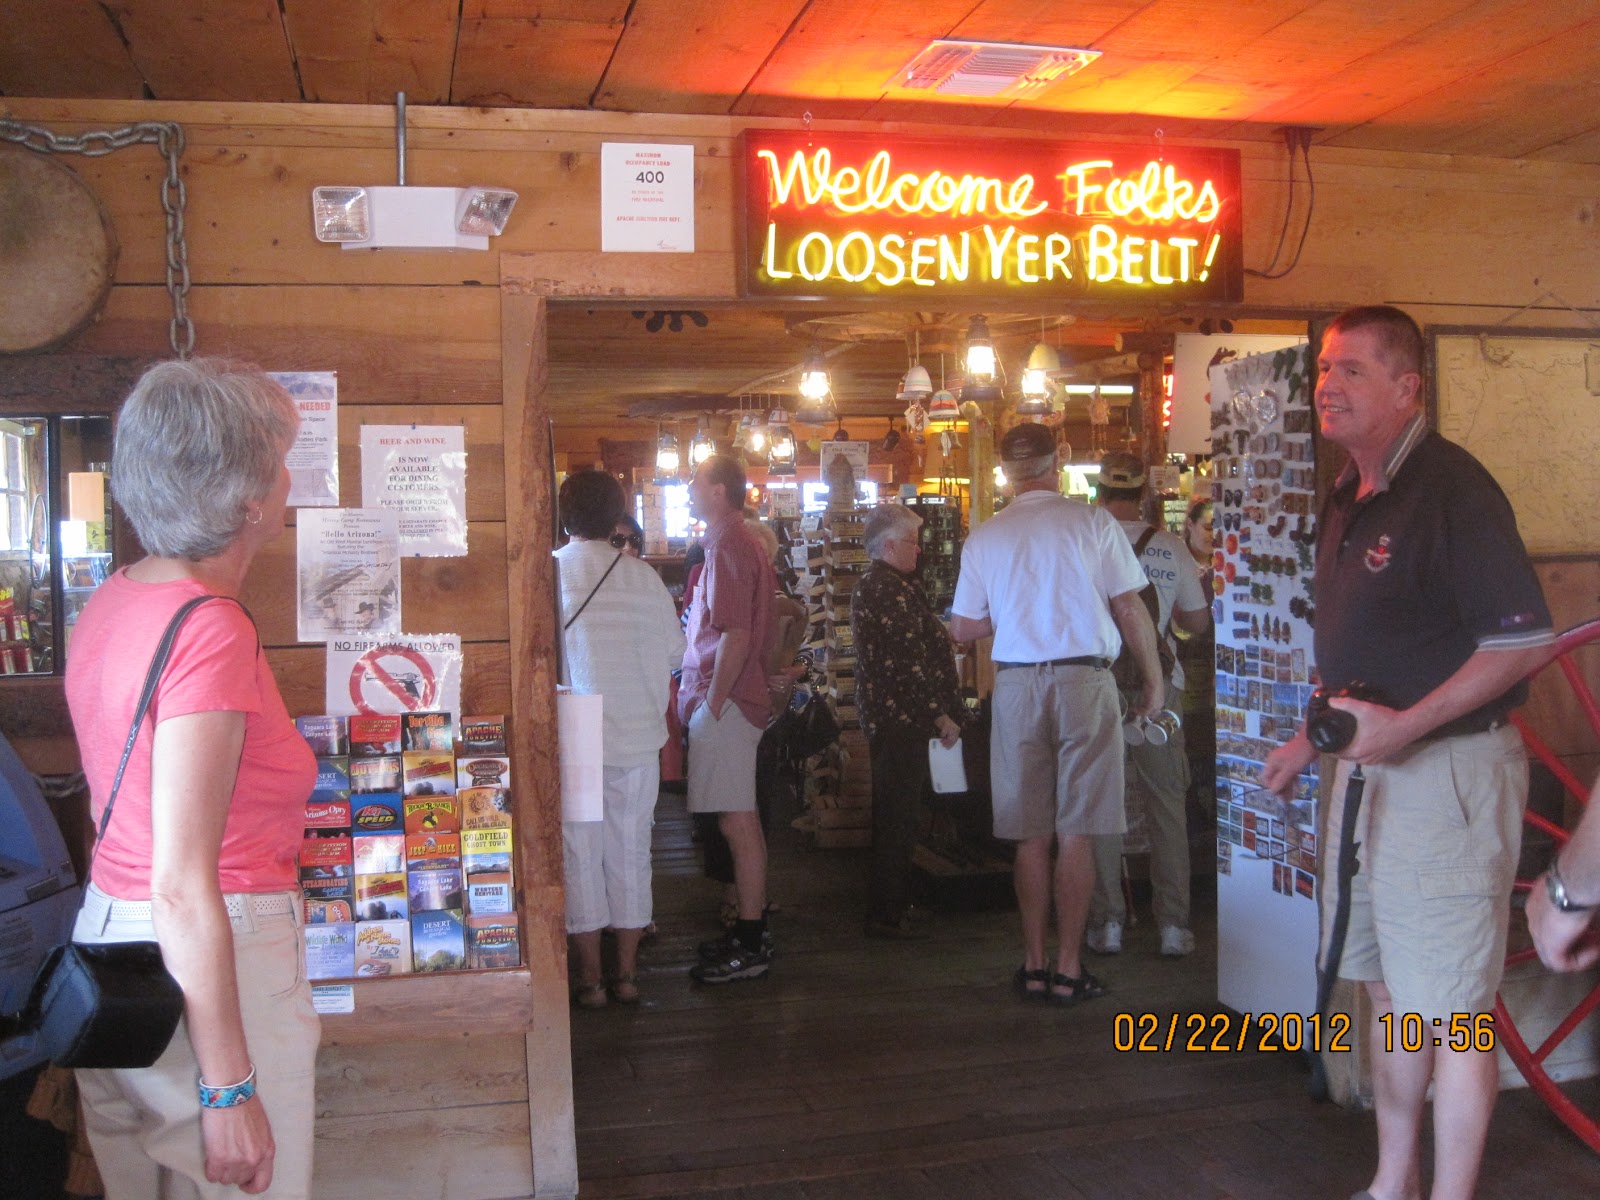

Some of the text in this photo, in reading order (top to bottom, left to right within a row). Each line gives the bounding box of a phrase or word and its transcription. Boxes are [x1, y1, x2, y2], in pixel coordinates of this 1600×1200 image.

[636, 171, 665, 183] 400
[758, 148, 1219, 222] Welcome Folks
[766, 221, 1221, 286] LOOSEN YER BELT!
[300, 401, 331, 411] NEEDED
[423, 437, 447, 445] WINE
[334, 641, 351, 651] NO
[465, 726, 503, 736] APACHE
[328, 805, 346, 816] Opry
[358, 815, 395, 824] SPEED
[463, 832, 509, 842] GOLDFIELD
[423, 920, 451, 929] DESERT
[329, 934, 348, 943] World
[476, 928, 516, 939] APACHE
